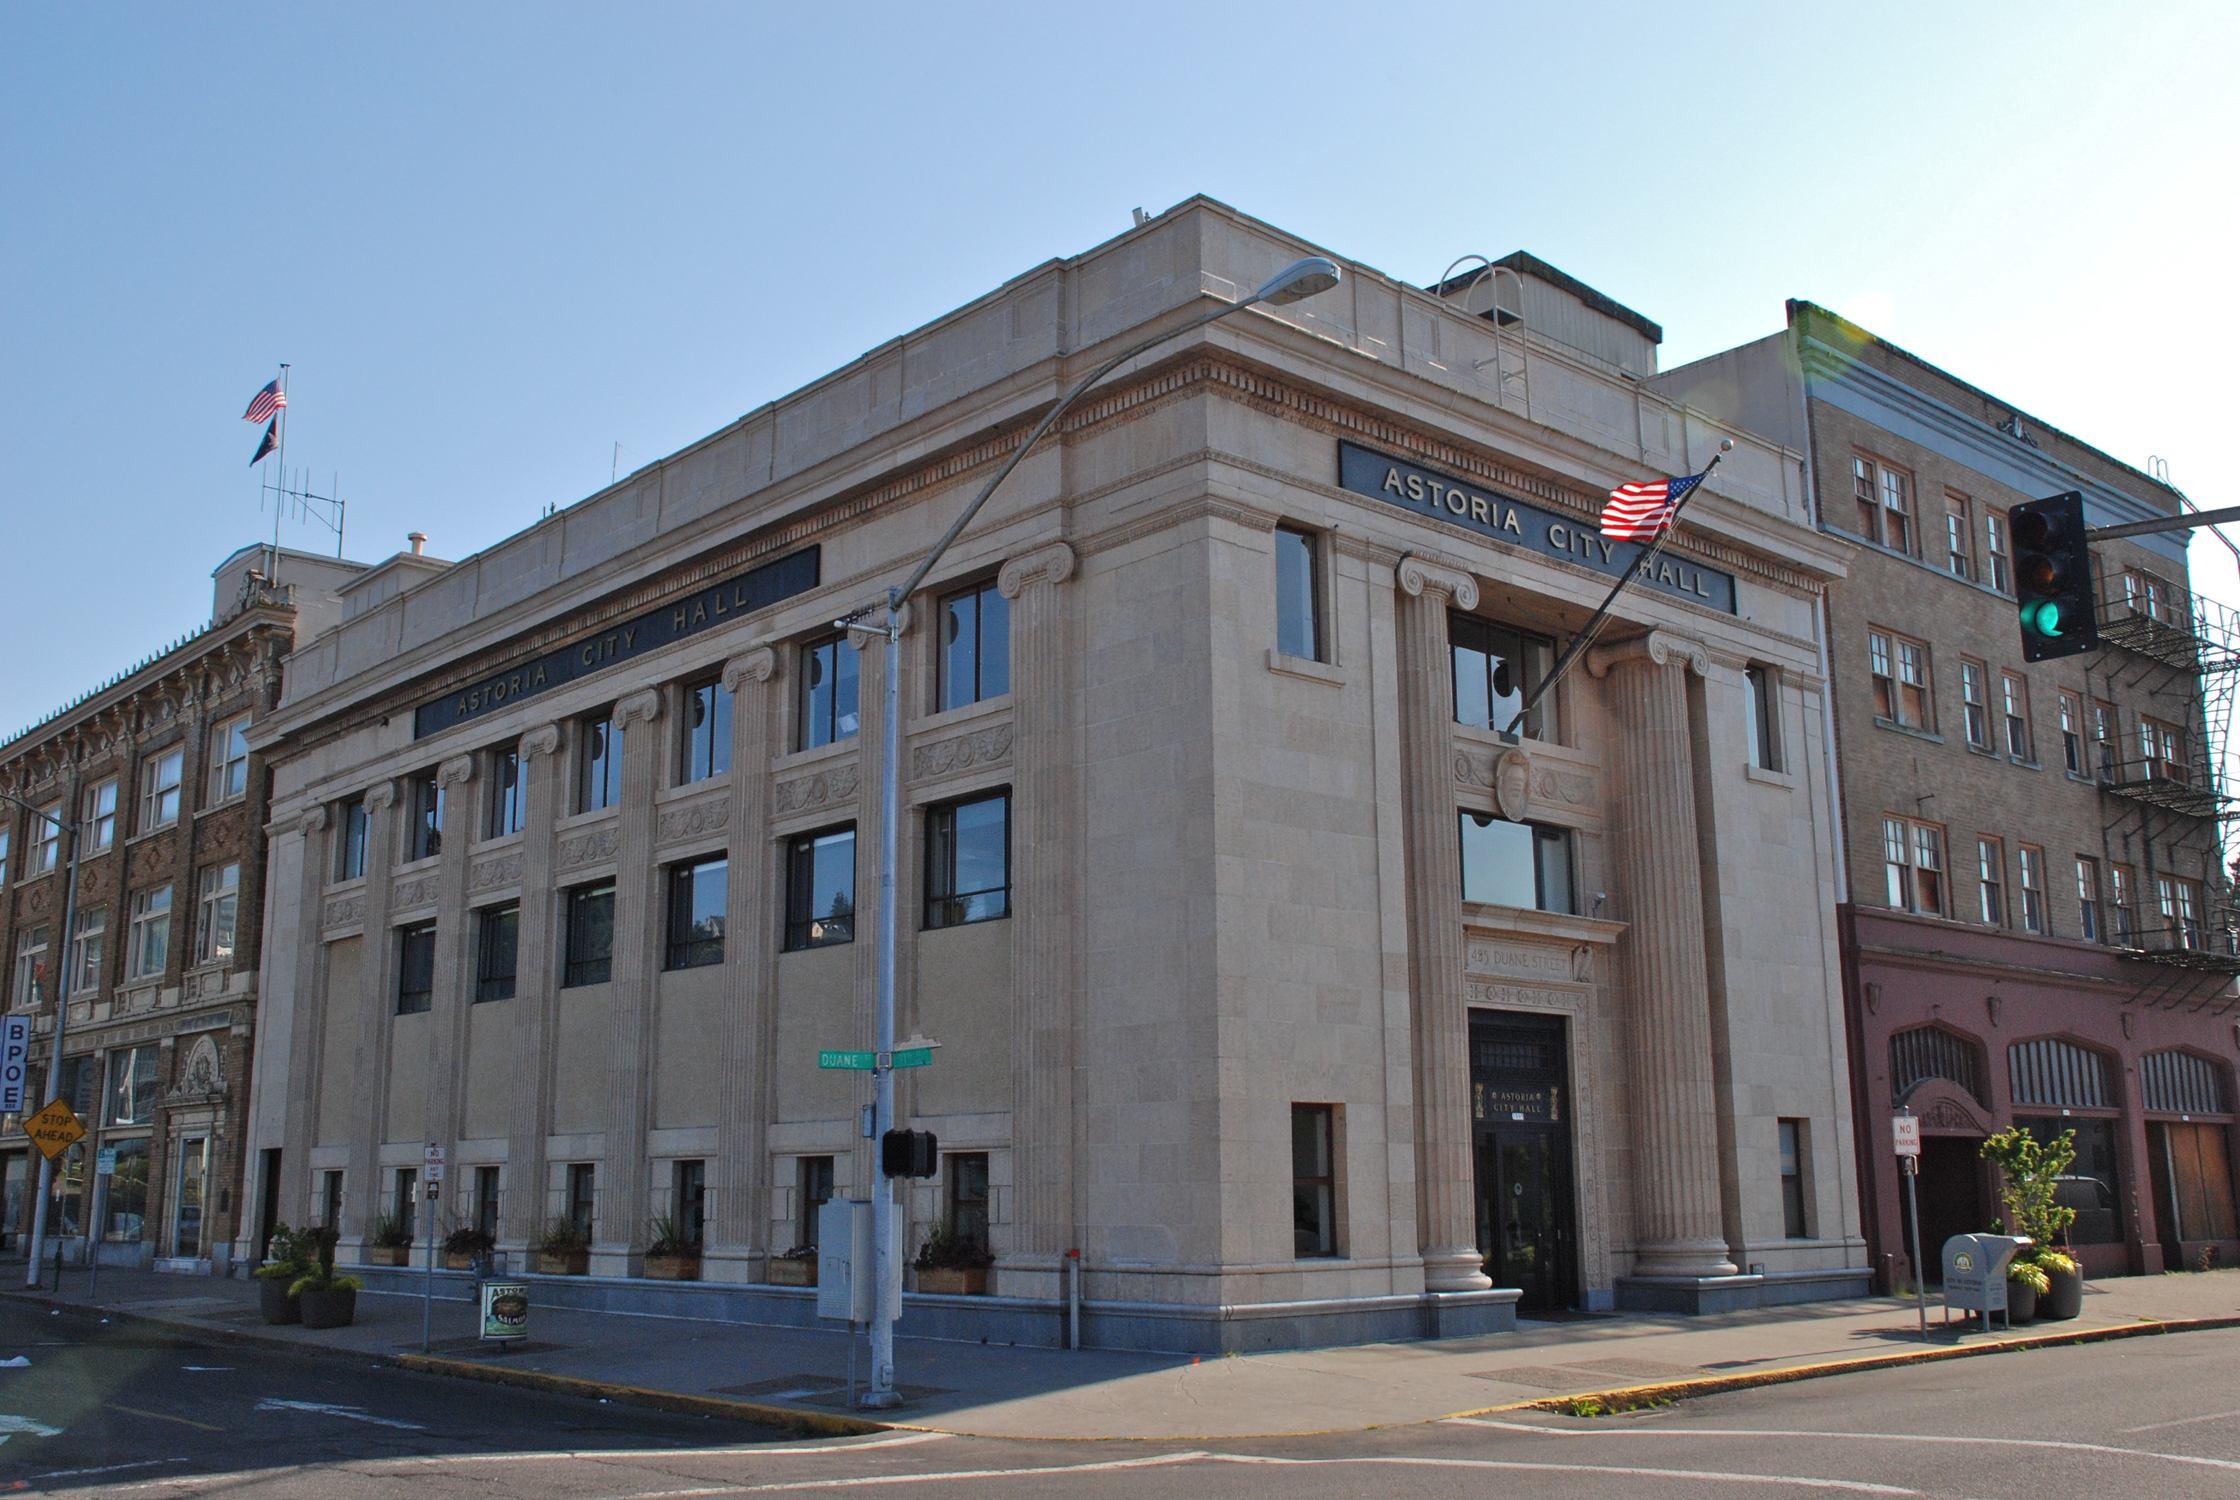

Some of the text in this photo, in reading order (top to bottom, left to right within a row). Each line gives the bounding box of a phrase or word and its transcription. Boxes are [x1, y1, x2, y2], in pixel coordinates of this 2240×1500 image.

[1384, 467, 1520, 535] ASTORIA
[1549, 524, 1614, 563] CITY
[456, 585, 747, 716] ASTORIA CITY HALL
[1494, 950, 1529, 969] DUANE
[1531, 955, 1566, 970] STREET
[4, 1024, 24, 1103] BPOE
[822, 1054, 858, 1067] DUANE
[1501, 1092, 1535, 1101] ASTORIA
[1493, 1104, 1541, 1113] CITY HALL
[41, 1113, 73, 1127] STOP
[34, 1129, 74, 1142] AHEAD
[1899, 1124, 1912, 1134] NO
